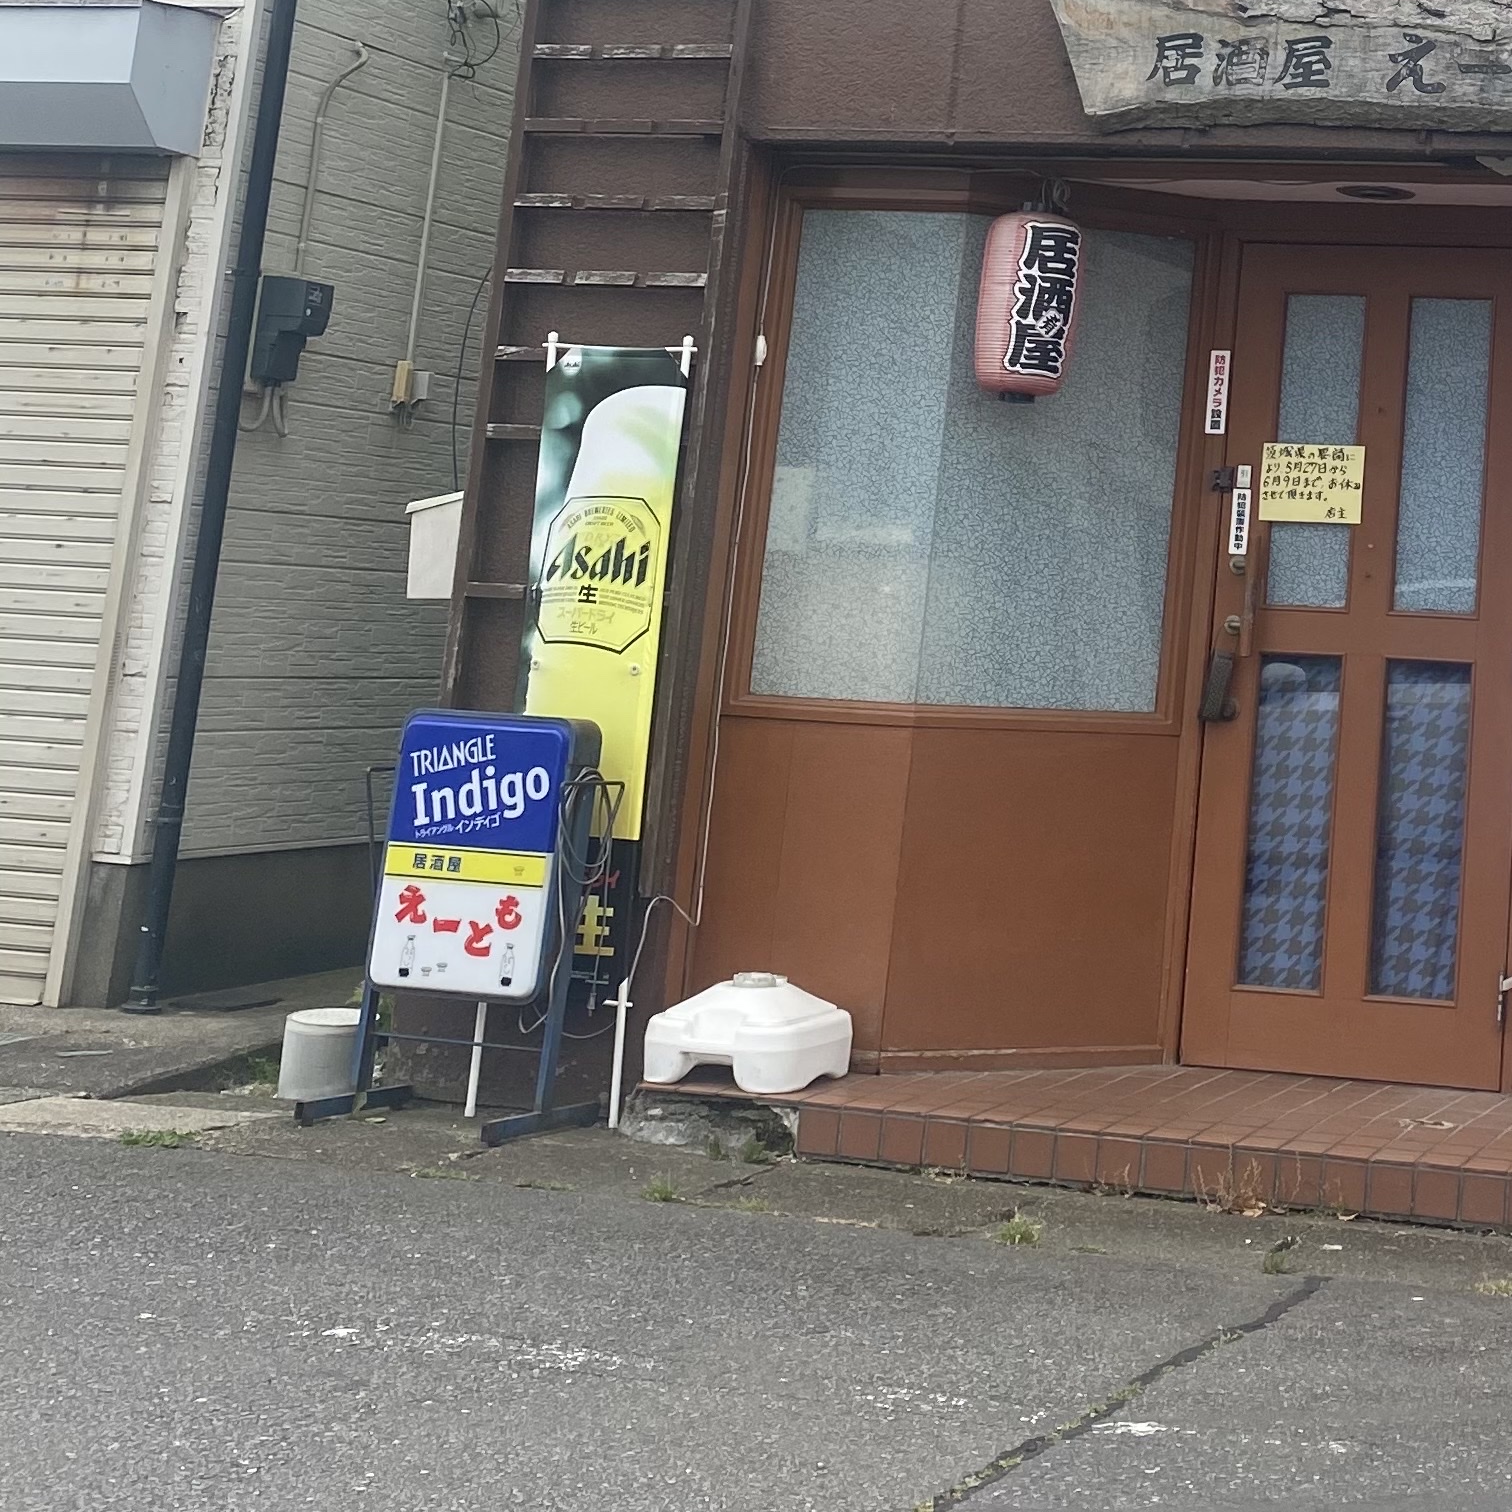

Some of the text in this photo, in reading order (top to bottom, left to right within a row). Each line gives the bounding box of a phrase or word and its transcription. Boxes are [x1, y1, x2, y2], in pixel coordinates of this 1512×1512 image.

[1146, 32, 1333, 90] 居酒屋
[1005, 221, 1081, 377] 居酒屋
[545, 531, 651, 588] Asahi
[578, 584, 599, 605] 生
[569, 621, 599, 635] 生ビール
[410, 734, 496, 777] TRIANGLE
[411, 764, 550, 827] Indigo
[412, 853, 462, 873] 居酒屋
[394, 884, 522, 958] えーとも
